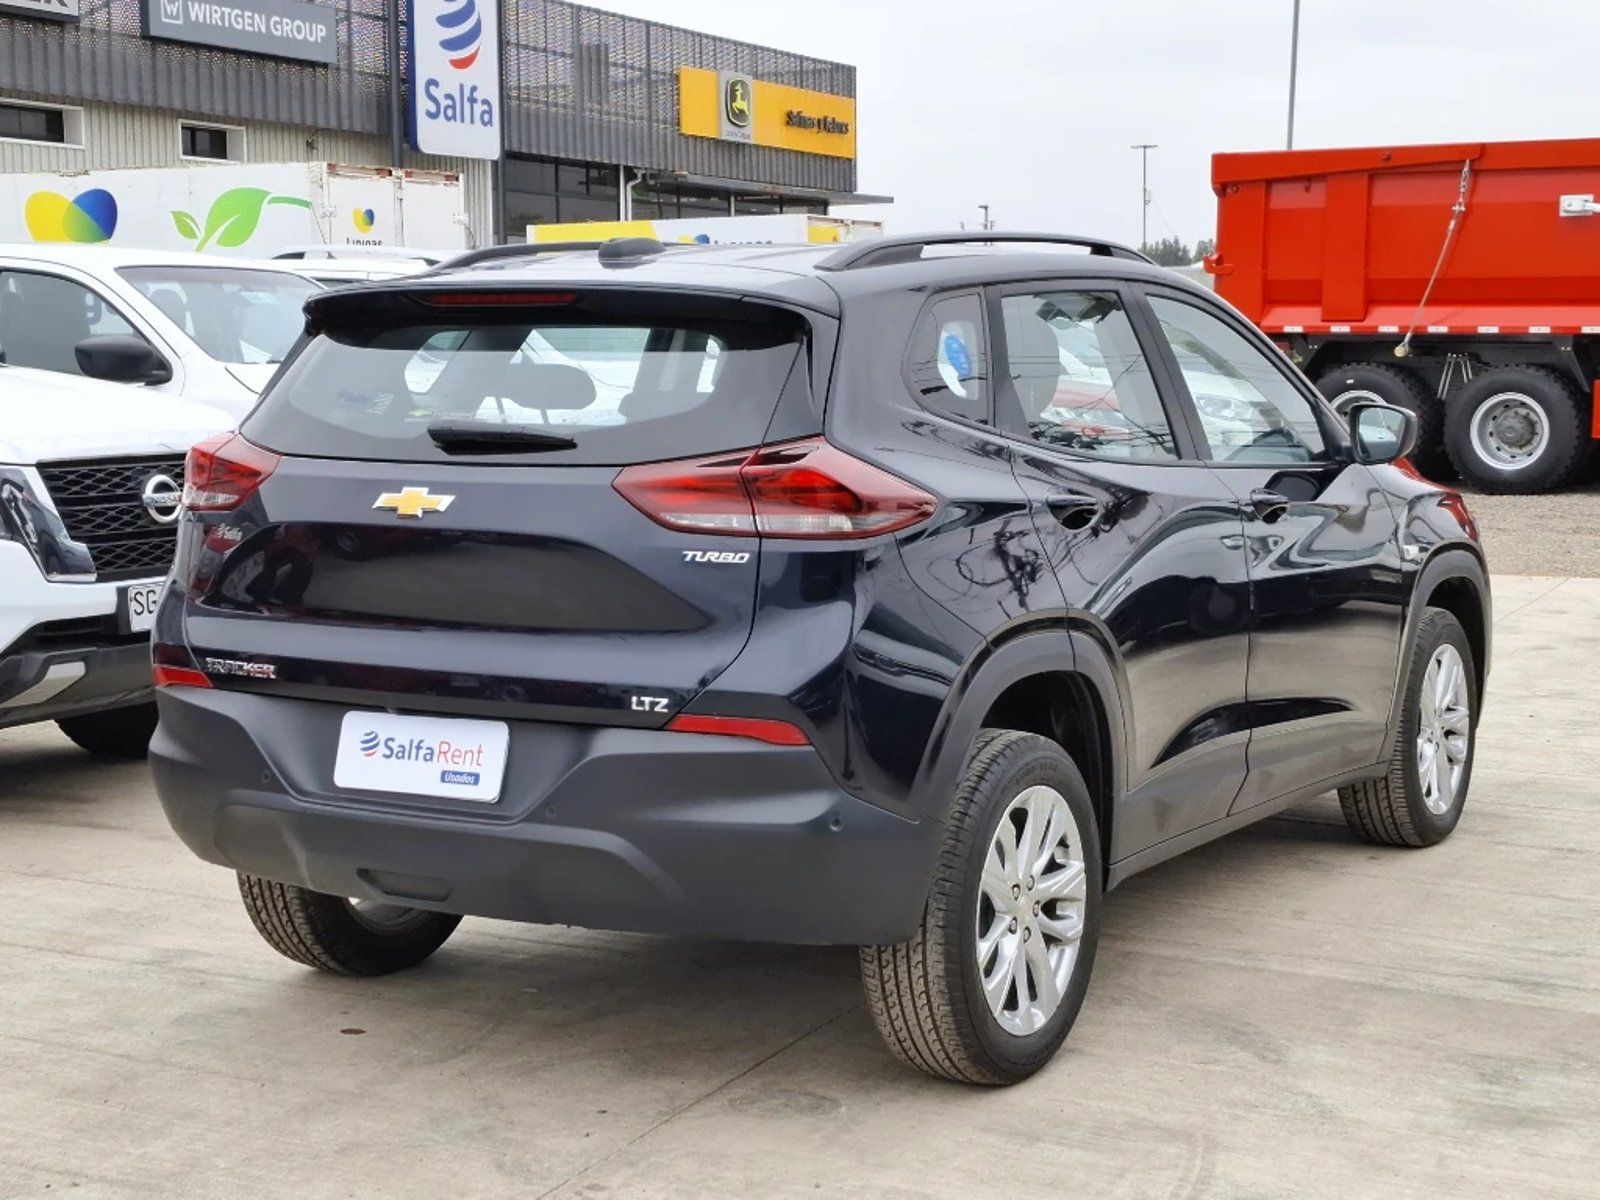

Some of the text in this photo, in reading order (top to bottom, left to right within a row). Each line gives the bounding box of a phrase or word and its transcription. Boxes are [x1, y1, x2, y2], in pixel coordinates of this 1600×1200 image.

[188, 1, 326, 43] WIRTGEN GROUP
[424, 77, 493, 127] Salfa
[682, 550, 751, 564] TURBO
[205, 657, 277, 679] TRACKER
[631, 695, 669, 713] LTZ
[382, 736, 485, 767] SalfaRent
[444, 771, 476, 784] Usados
